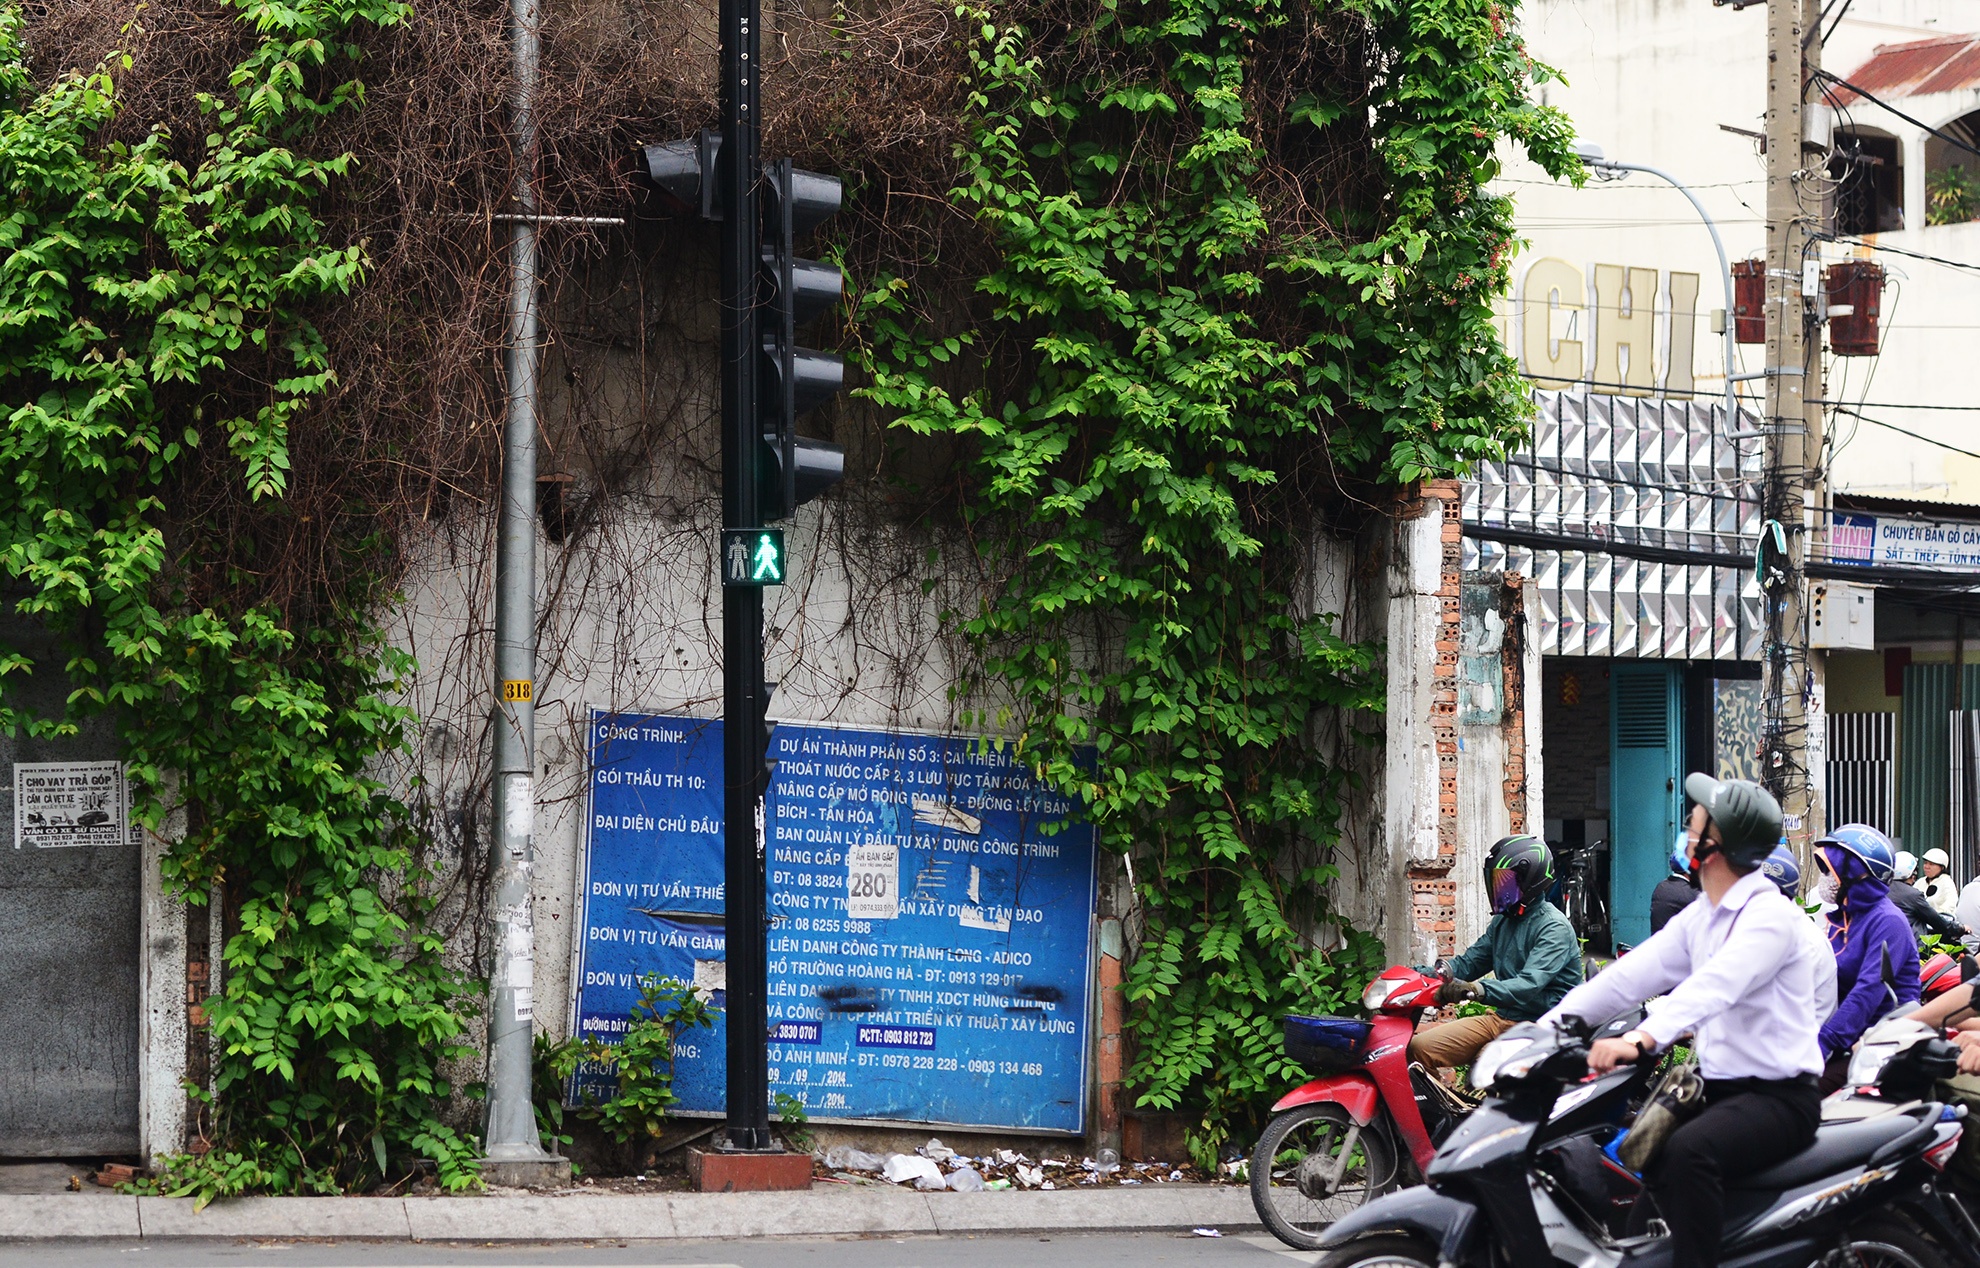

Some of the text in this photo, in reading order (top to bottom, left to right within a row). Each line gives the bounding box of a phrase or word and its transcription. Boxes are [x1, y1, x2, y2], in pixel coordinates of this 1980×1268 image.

[1515, 257, 1700, 400] CHI
[1823, 516, 1873, 560] HÍNH
[506, 683, 530, 698] 318
[599, 723, 638, 741] CÔNG
[780, 739, 798, 754] DỰ
[802, 740, 820, 754] ÁN
[823, 740, 866, 758] THÀNH
[870, 743, 905, 760] PHẦN
[908, 745, 926, 761] SỐ
[929, 751, 940, 762] 3:
[26, 773, 112, 787] CHO VAY TRẢ GÓP
[597, 768, 706, 789] GÓI THẦU TH 10:
[779, 760, 822, 776] THOÁT
[825, 763, 861, 779] NƯỚC
[864, 763, 890, 781] CẤP
[907, 771, 914, 782] 3
[67, 794, 75, 803] XE
[777, 781, 814, 797] NÂNG
[818, 782, 844, 799] CẤP
[848, 782, 868, 801] MỞ
[967, 794, 1013, 811] ĐƯỜNG
[595, 814, 719, 834] ĐẠI DIỆN CHỦ ĐẦU
[777, 803, 875, 824] BÍCH TÂN HÓA
[776, 826, 1060, 858] BAN QUẢN LÝ ĐẦU TƯ XÂY DỰNG CÔNG TRÌNH
[775, 847, 811, 865] NÂNG
[814, 848, 841, 866] CẤP
[592, 880, 725, 900] ĐƠN VỊ TƯ VẤN THIẾ
[773, 871, 794, 885] ĐT:
[797, 873, 812, 886] 08
[815, 875, 843, 888] 3824
[851, 873, 887, 898] 280
[773, 891, 809, 909] CÔNG
[814, 896, 828, 911] TY
[833, 897, 850, 911] TN
[898, 897, 916, 915] ẤN
[919, 901, 945, 917] XÂY
[987, 904, 1013, 921] TÂN
[1016, 909, 1043, 924] ĐẠO
[795, 918, 809, 931] 08
[812, 920, 840, 932] 6255
[843, 921, 871, 934] 9988
[590, 926, 725, 951] ĐƠN VỊ TƯ VẤN GIÁM
[770, 936, 1032, 966] LIÊN DANH CÔNG TY THÀNH LONG ADICO
[586, 971, 615, 985] ĐƠN
[620, 974, 631, 990] VỊ
[768, 956, 788, 974] HỒ
[791, 959, 844, 977] TRƯỜNG
[848, 962, 893, 980] HOÀNG
[896, 966, 914, 981] HÀ
[925, 969, 945, 983] ĐT:
[949, 971, 976, 984] 0913
[980, 973, 1000, 986] 129
[767, 980, 796, 997] LIÊN
[880, 988, 895, 1001] TY
[899, 989, 932, 1004] TNHH
[936, 992, 970, 1007] XDCT
[973, 992, 1009, 1008] HÙNG
[611, 1018, 627, 1032] DÂY
[767, 1002, 783, 1018] VÀ
[787, 1003, 824, 1020] CÔNG
[868, 1008, 901, 1024] PHÁT
[905, 1007, 942, 1026] TRIỂN
[967, 1014, 1008, 1032] THUẬT
[1011, 1017, 1037, 1032] XÂY
[1040, 1019, 1075, 1036] DỰNG
[780, 1025, 798, 1039] 3830
[799, 1026, 817, 1040] 0701
[860, 1029, 933, 1046] PCTT: 0903 812 723
[785, 1049, 812, 1063] ANH
[815, 1052, 847, 1065] MINH
[858, 1053, 879, 1066] ĐT:
[883, 1056, 910, 1068] 0978
[913, 1057, 933, 1069] 228
[937, 1058, 957, 1071] 228
[968, 1060, 995, 1073] 0903
[999, 1062, 1018, 1075] 134
[1022, 1063, 1043, 1076] 468
